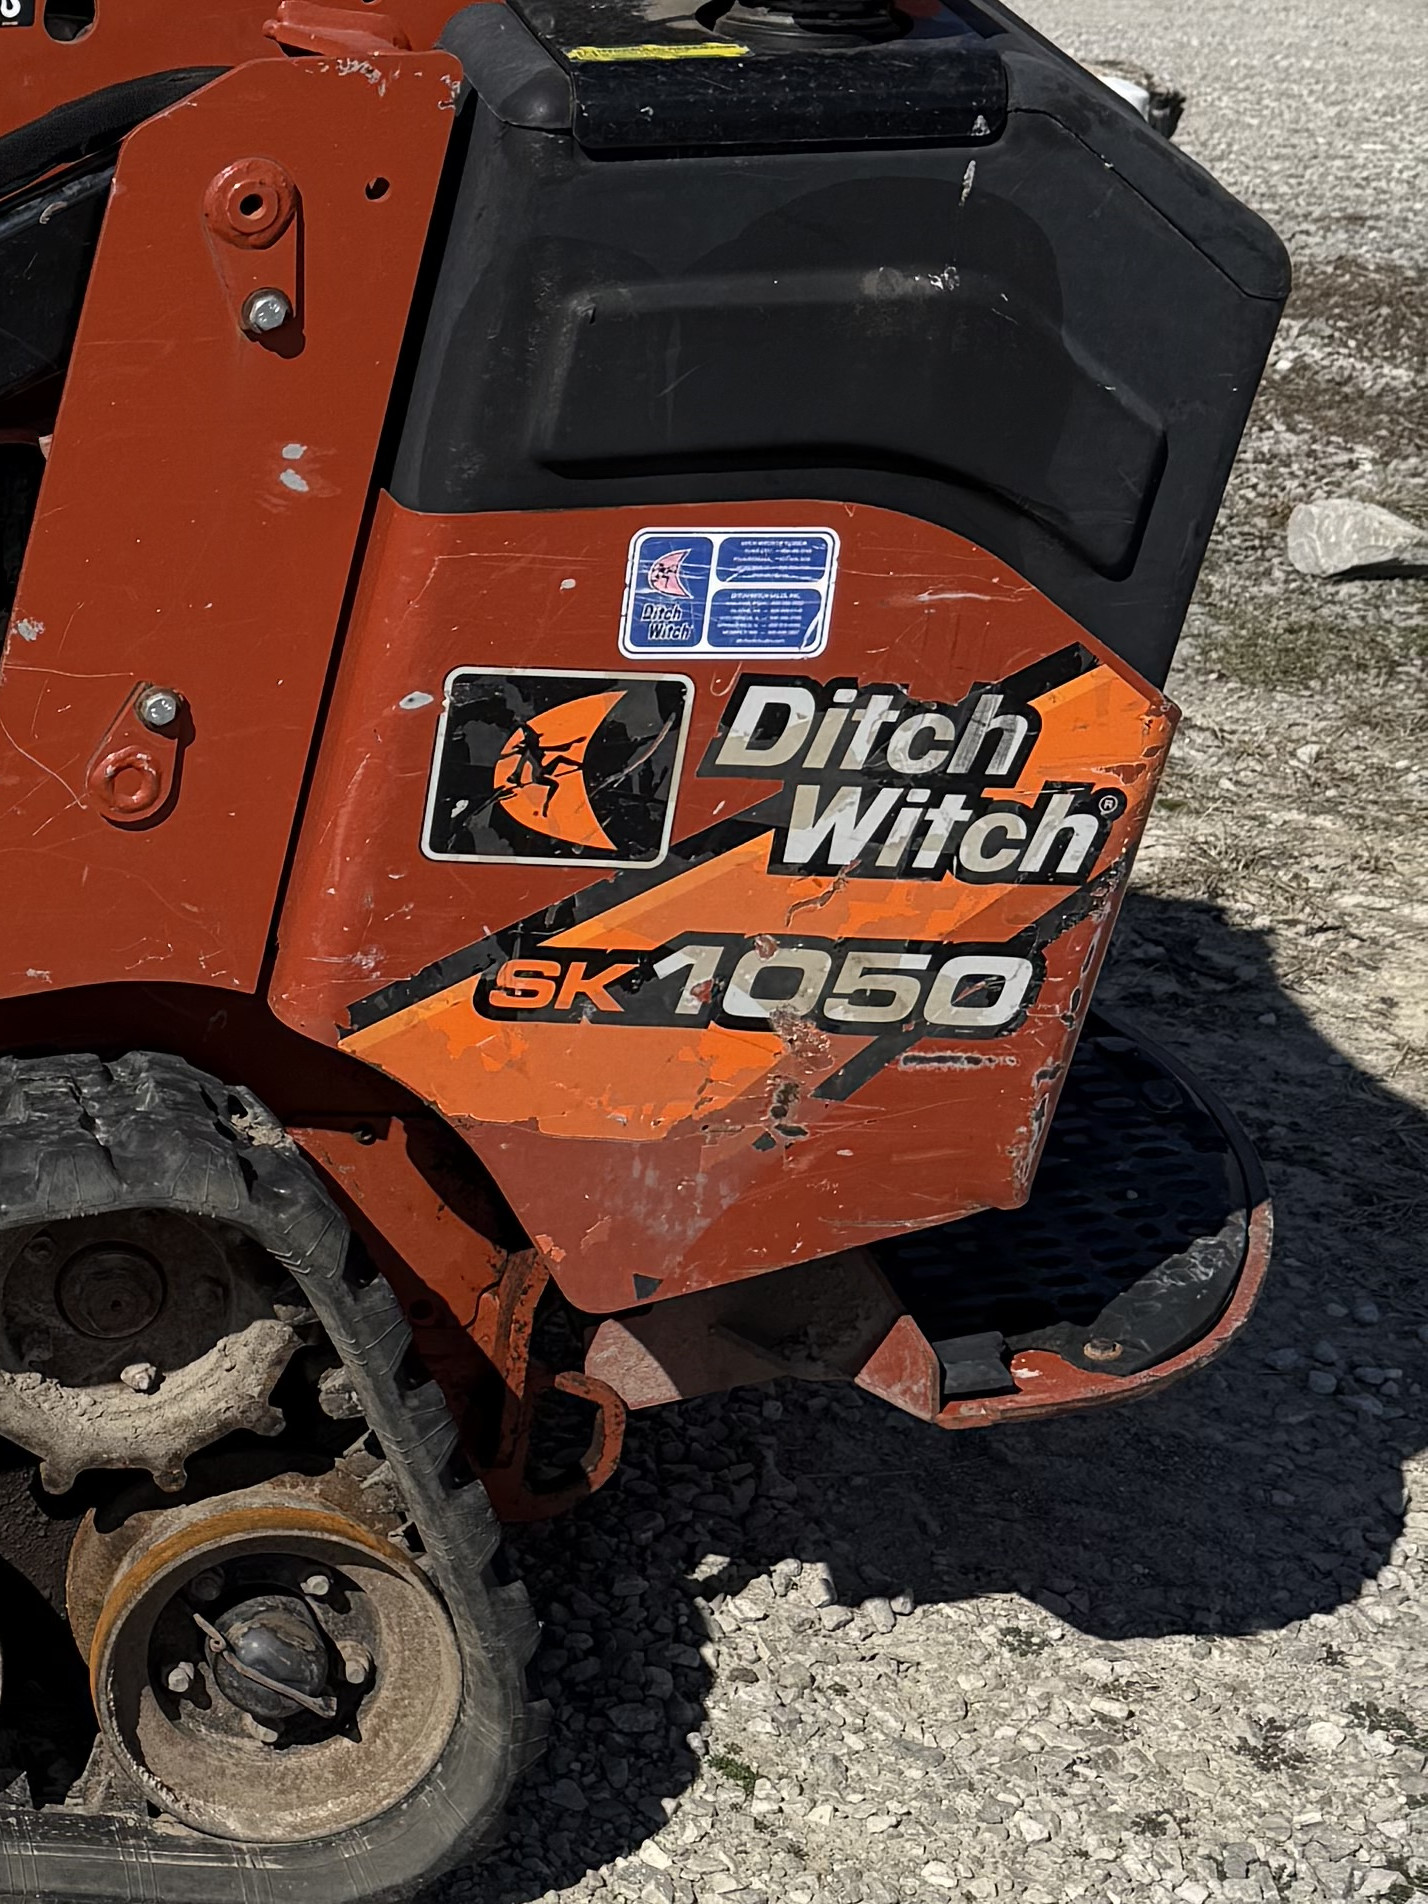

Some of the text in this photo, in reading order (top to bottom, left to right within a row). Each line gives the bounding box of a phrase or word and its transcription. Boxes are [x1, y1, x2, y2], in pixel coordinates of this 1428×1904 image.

[640, 603, 683, 622] Ditch
[647, 622, 693, 640] Witch
[715, 684, 1030, 776] Ditch
[782, 783, 1101, 875] Witch
[488, 945, 1035, 1027] SK 1050
